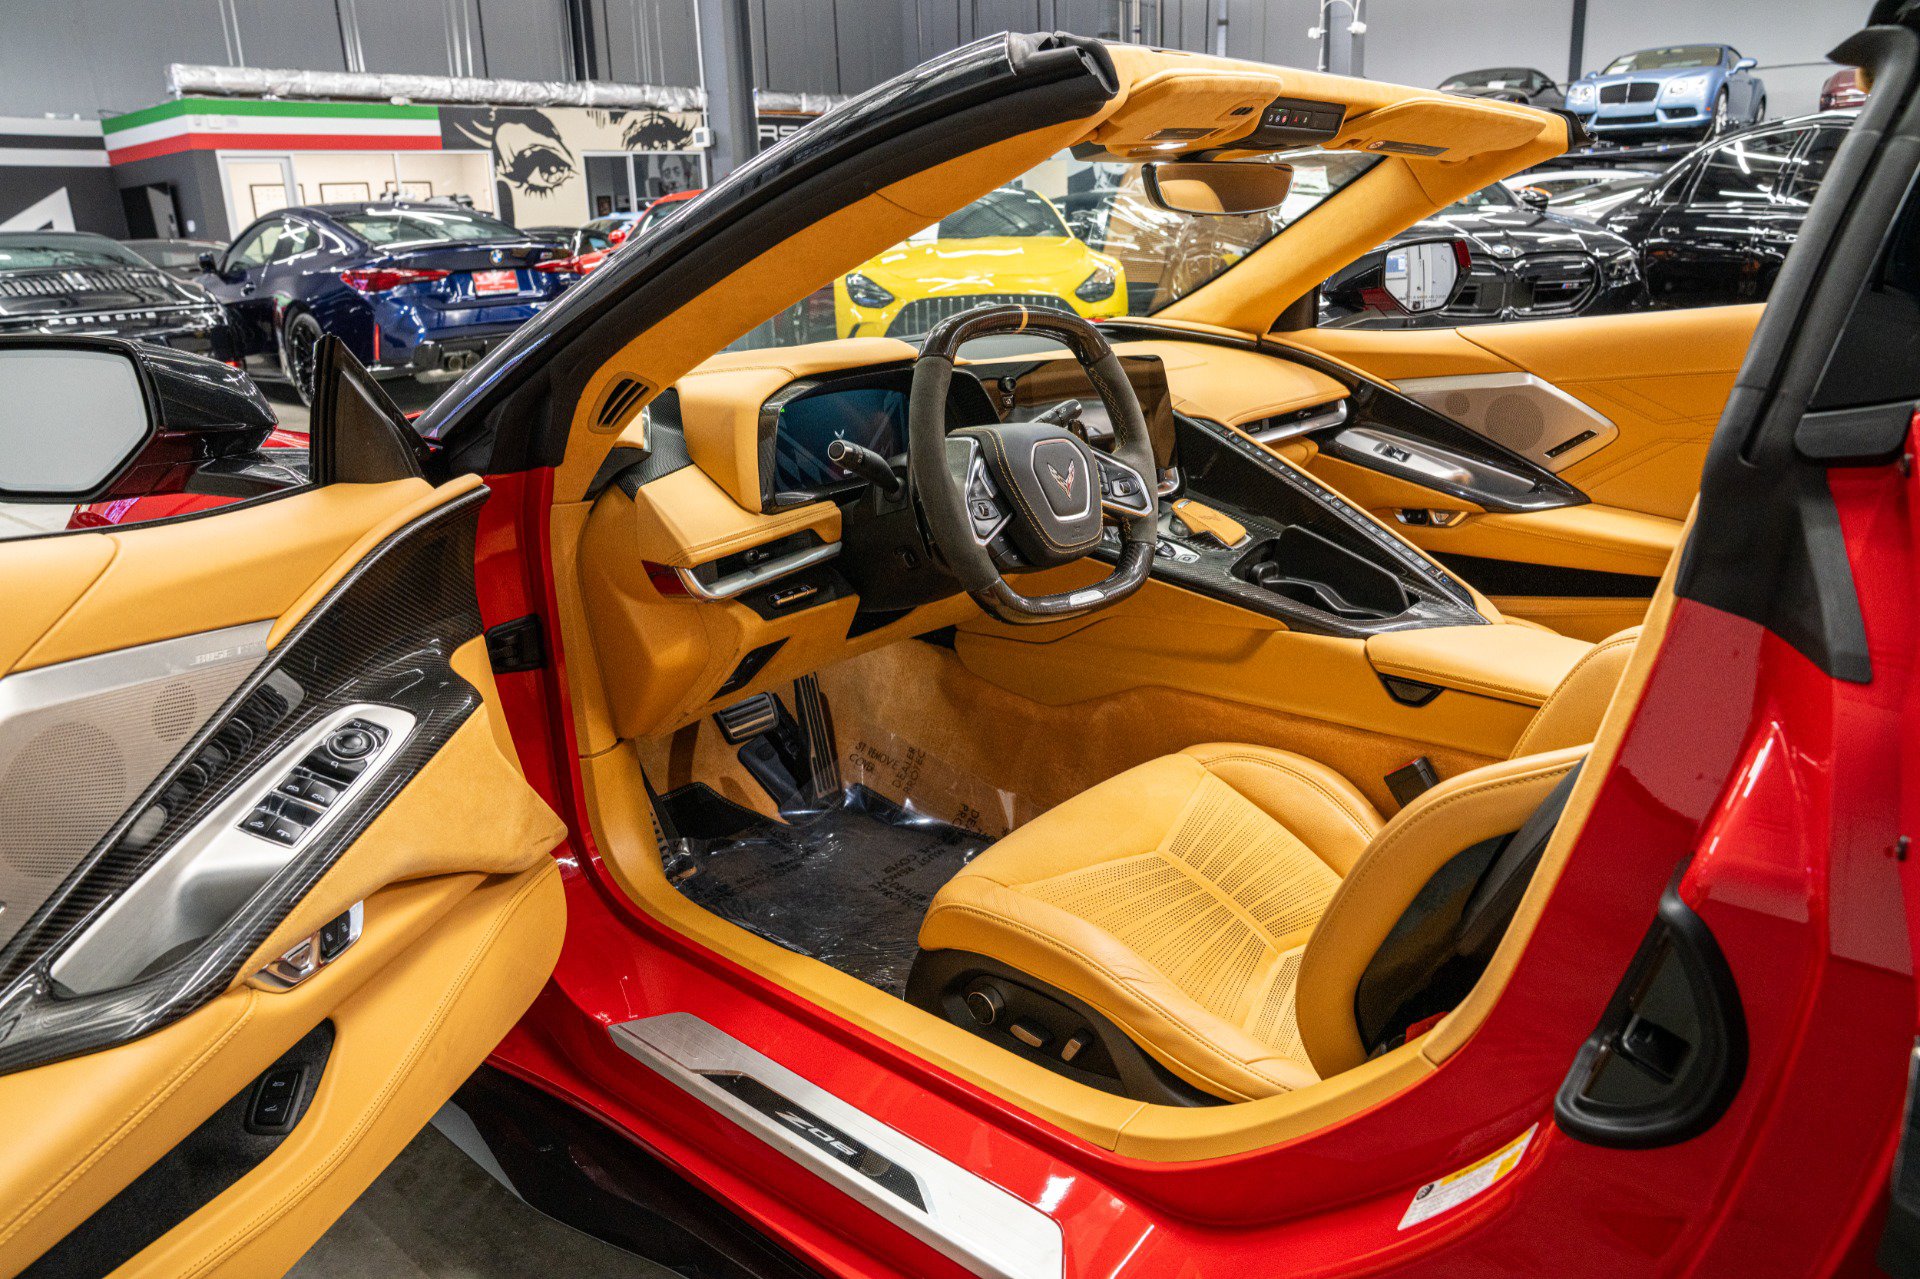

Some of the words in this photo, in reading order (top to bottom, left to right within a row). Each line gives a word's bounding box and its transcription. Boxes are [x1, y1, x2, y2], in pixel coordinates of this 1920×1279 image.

[48, 311, 157, 325] PORSCHE
[891, 746, 916, 789] DEALER
[774, 1110, 859, 1156] Z06
